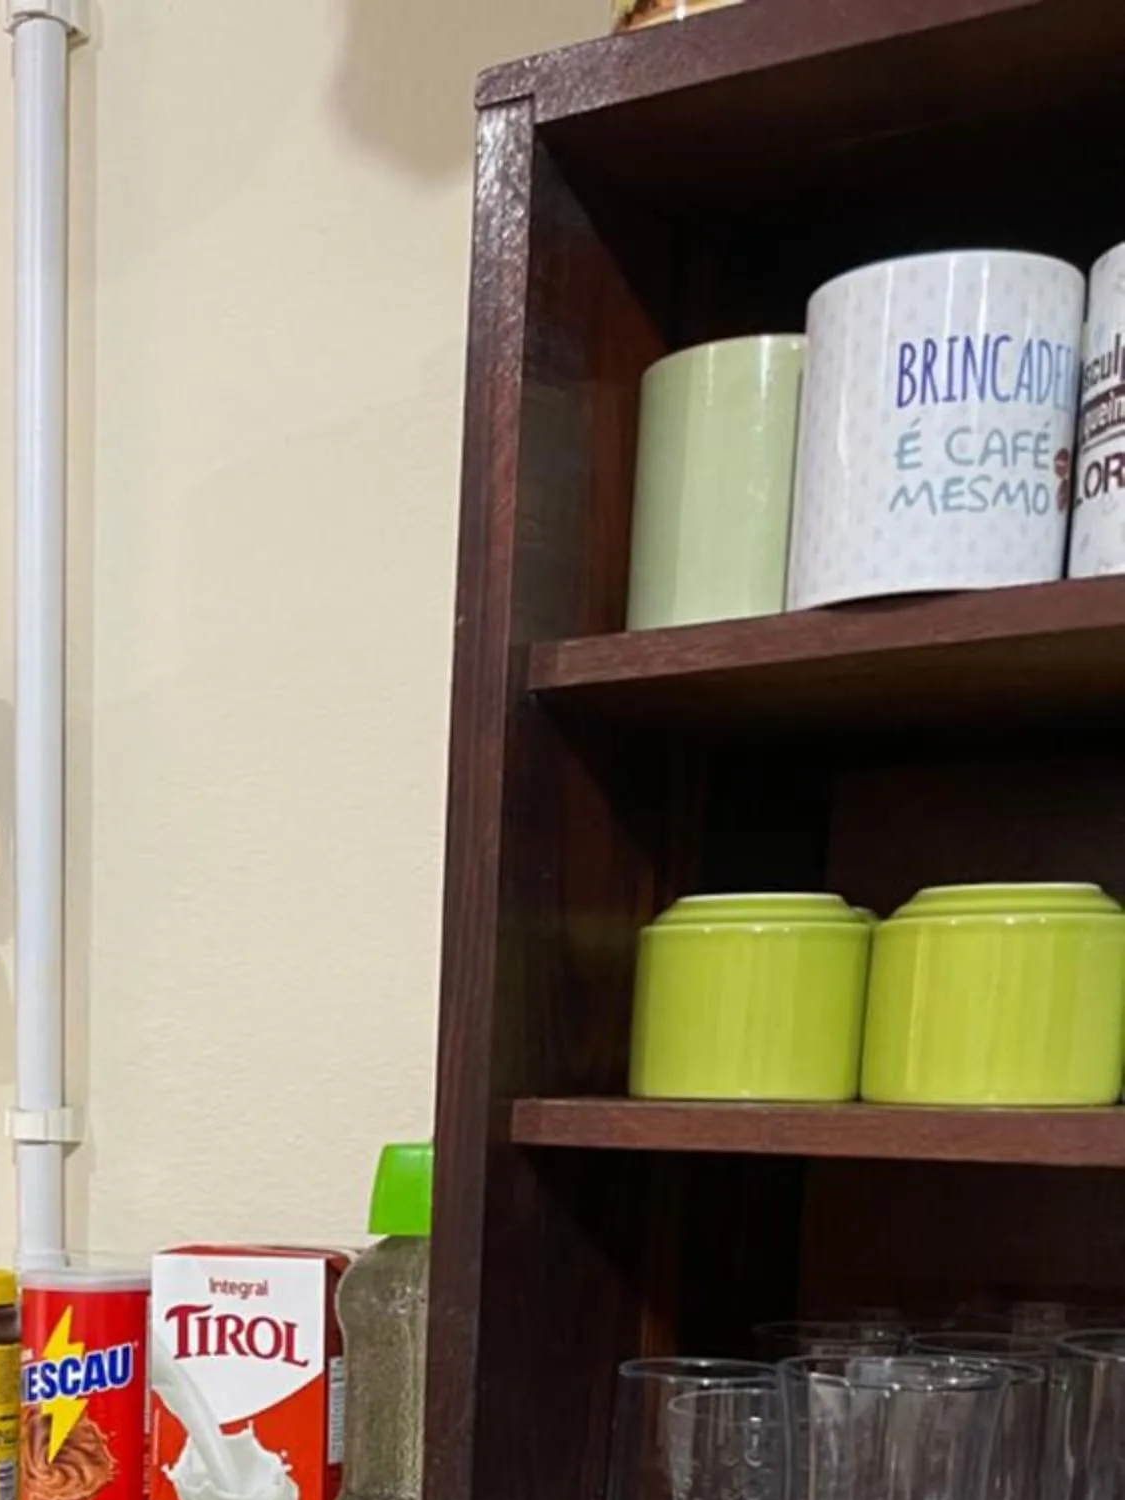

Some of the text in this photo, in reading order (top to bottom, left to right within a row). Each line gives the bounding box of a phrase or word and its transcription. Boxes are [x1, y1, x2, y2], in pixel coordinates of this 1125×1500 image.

[893, 417, 1051, 471] É CAFÉ
[888, 474, 1051, 516] MESMO
[208, 1277, 269, 1300] Integral
[165, 1304, 309, 1368] TIROL
[21, 1341, 134, 1407] ESCAU
